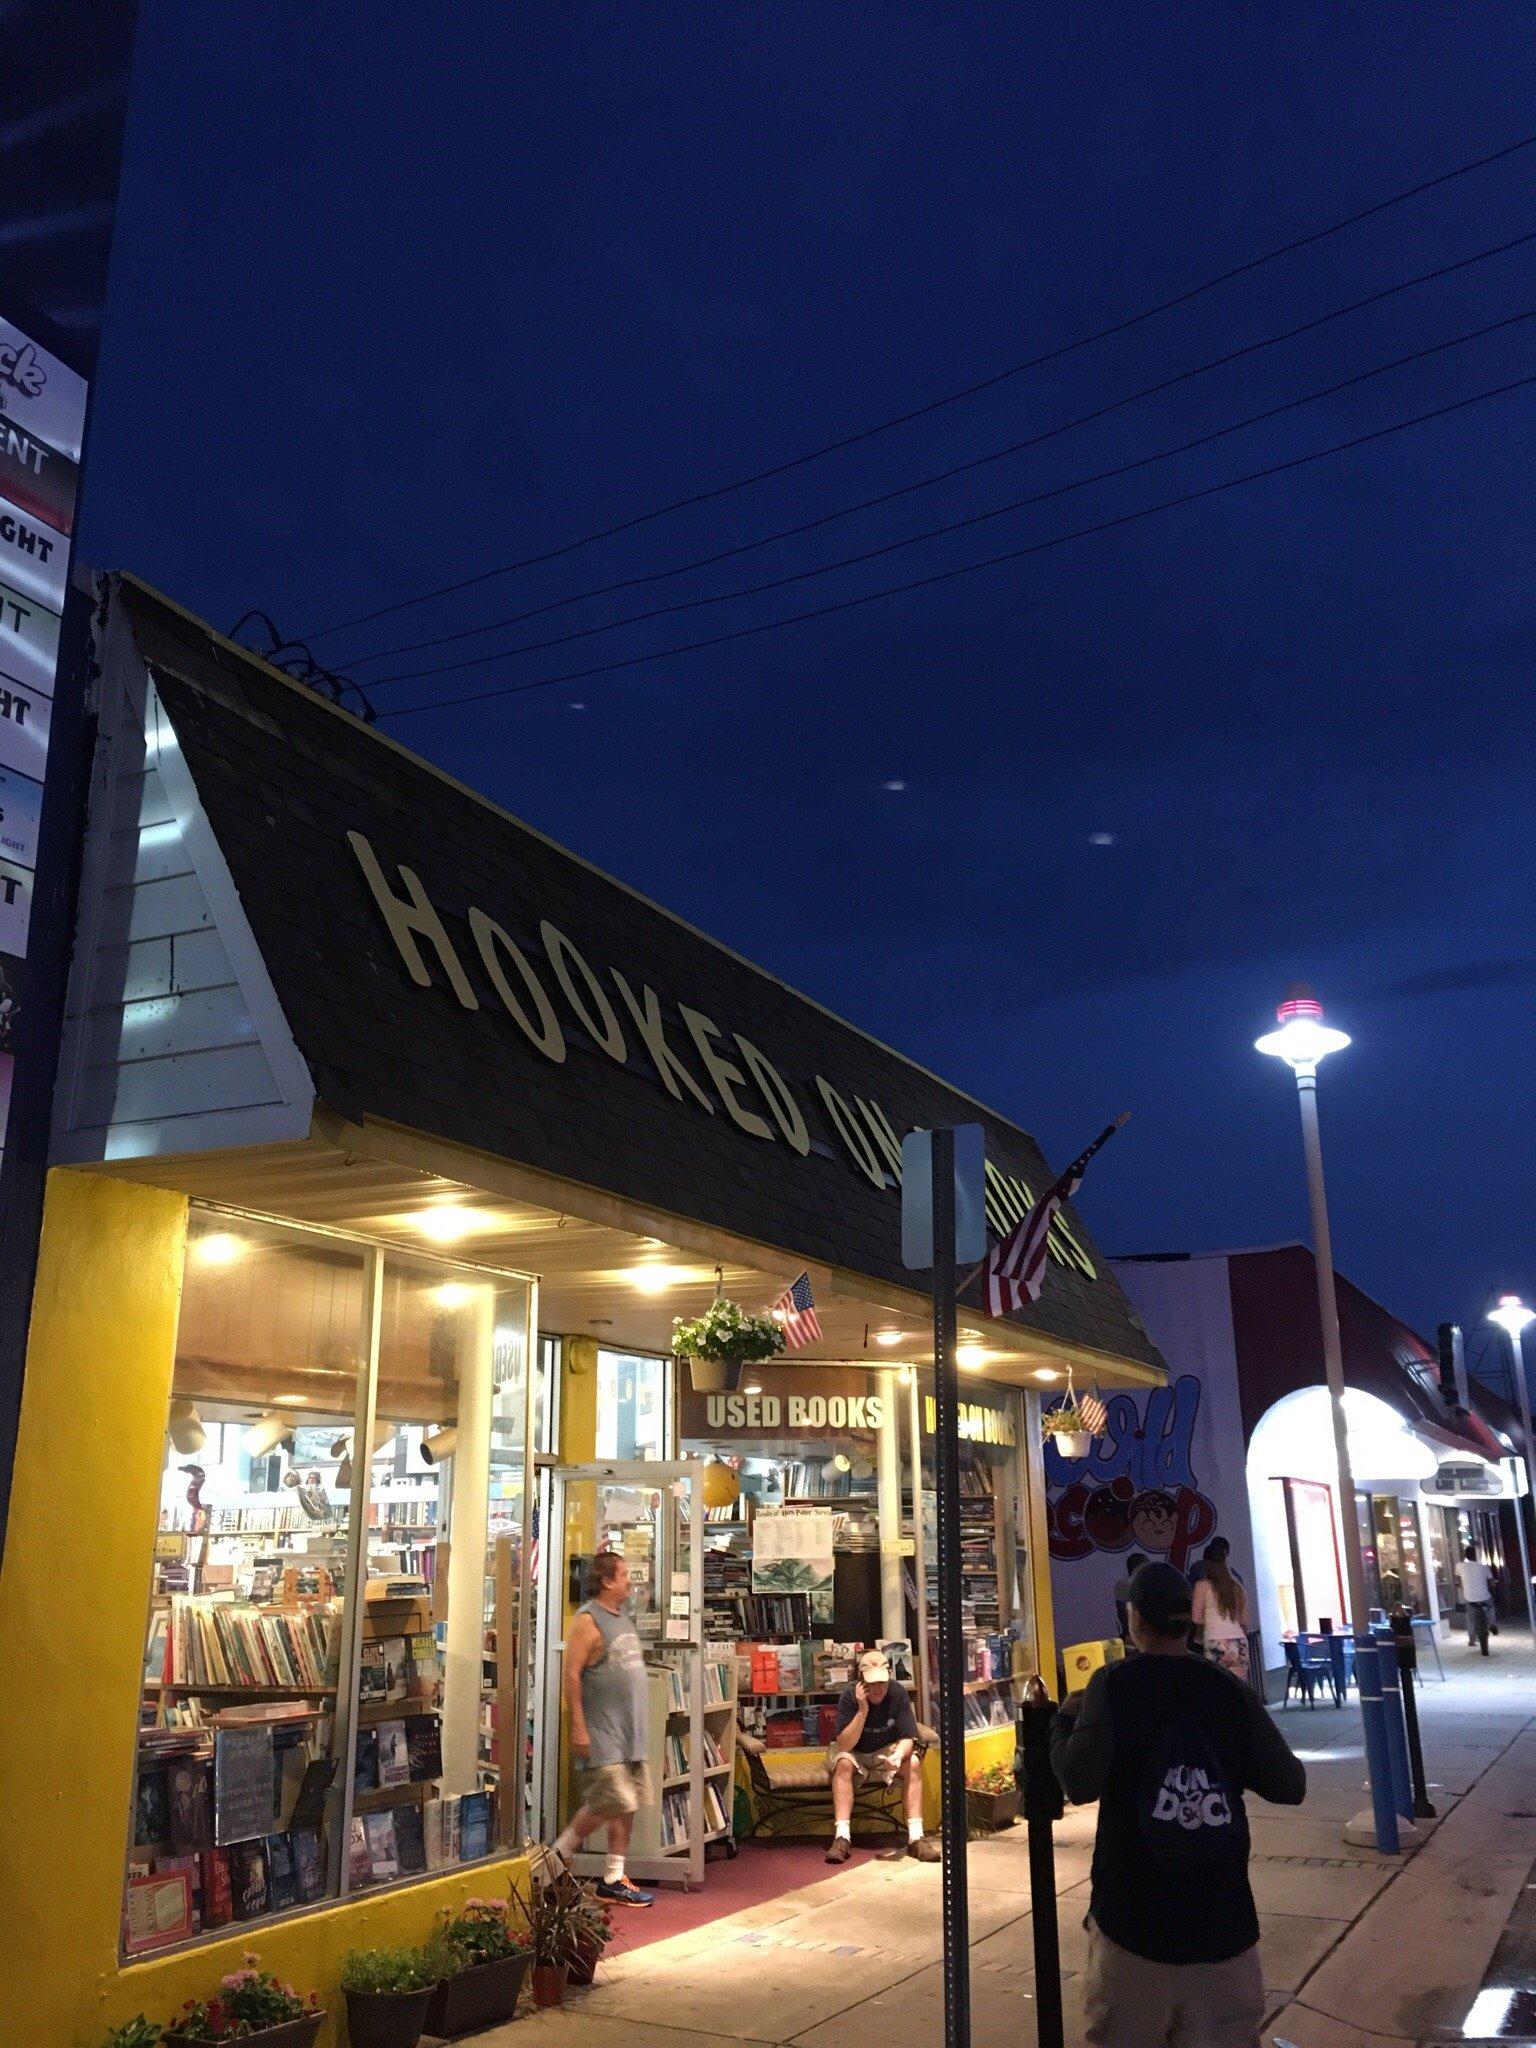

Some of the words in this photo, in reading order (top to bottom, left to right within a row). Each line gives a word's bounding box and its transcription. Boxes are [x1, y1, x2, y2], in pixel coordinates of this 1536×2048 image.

[0, 515, 53, 563] GHT
[347, 830, 810, 1156] HOOKED
[707, 1396, 781, 1428] USED
[788, 1396, 884, 1428] BOOKS
